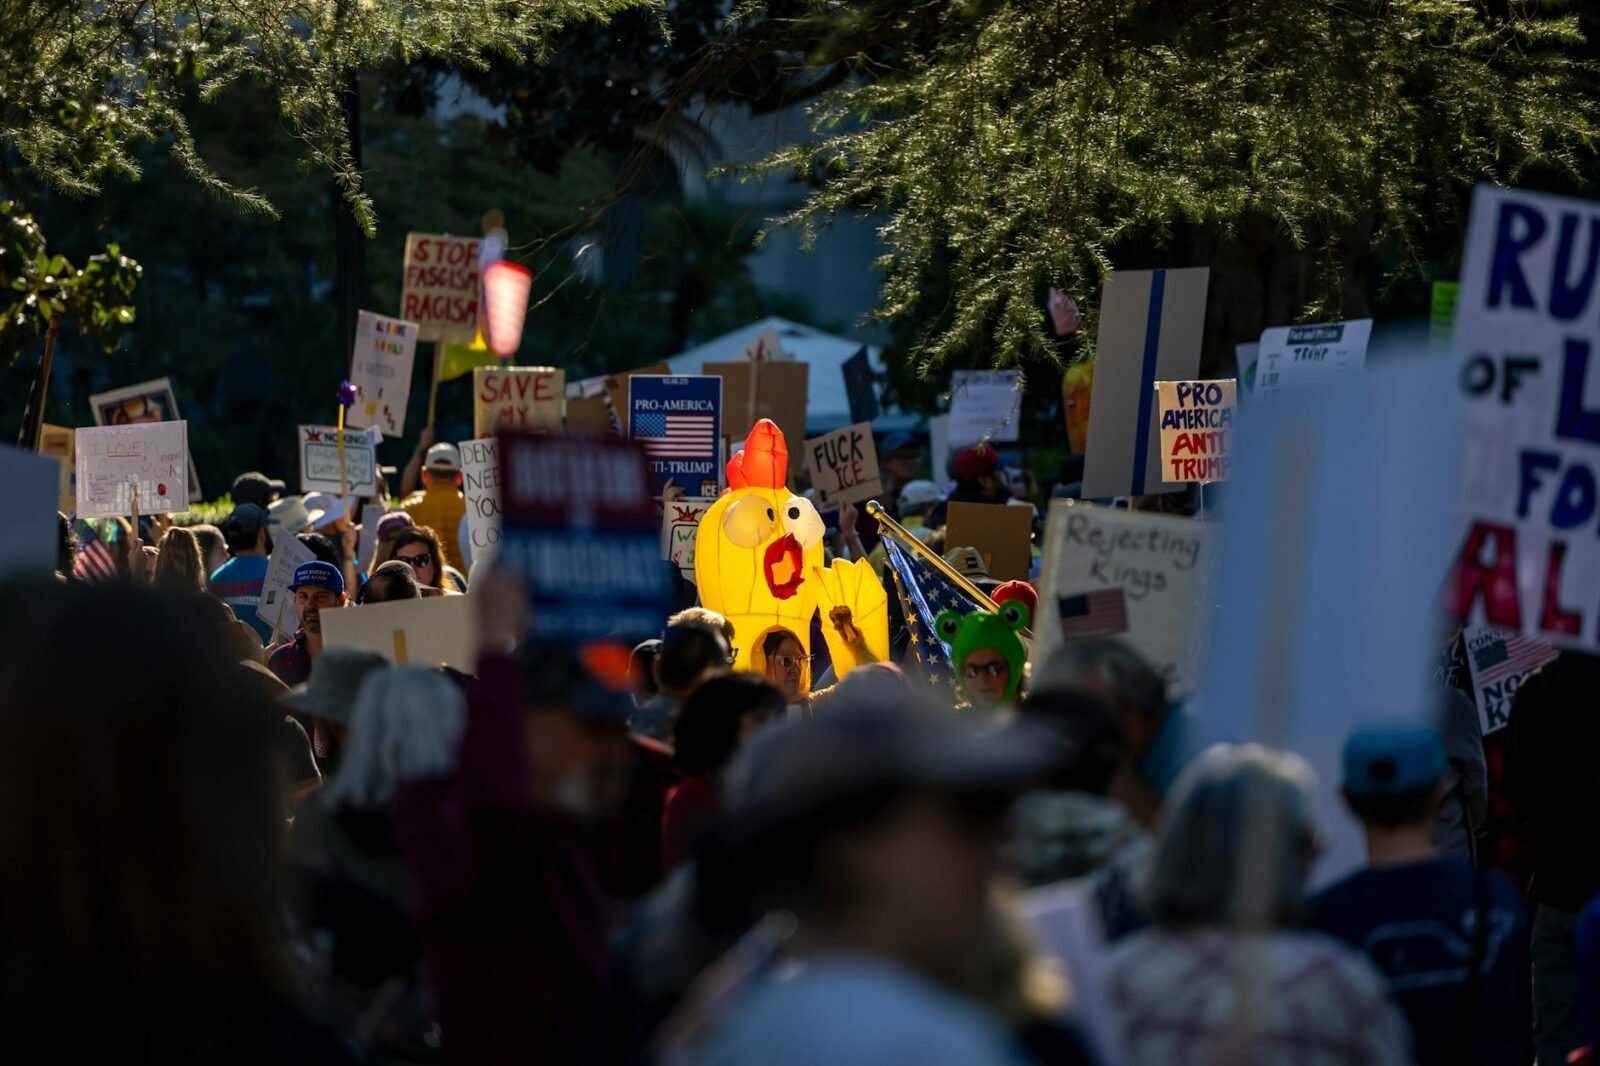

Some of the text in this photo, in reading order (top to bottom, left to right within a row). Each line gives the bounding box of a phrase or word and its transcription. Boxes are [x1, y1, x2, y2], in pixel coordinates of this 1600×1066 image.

[1487, 203, 1600, 321] RU
[1294, 347, 1329, 361] TRUMP
[480, 375, 554, 402] SAVE
[1177, 383, 1223, 408] PRO
[1460, 335, 1600, 443] OF L
[500, 405, 529, 425] MY
[635, 400, 714, 410] PRO-AMERICA
[1162, 408, 1231, 430] AMERICA
[107, 440, 141, 456] LOVE
[462, 443, 500, 465] DEM
[814, 431, 863, 473] FUCK
[1171, 432, 1226, 456] ANTI
[466, 468, 500, 490] NEE
[651, 461, 713, 473] TI-TRUMP
[835, 461, 864, 490] ICE
[1171, 457, 1229, 480] TRUMP
[701, 485, 717, 496] ICE
[1517, 451, 1600, 528] FO
[472, 527, 503, 548] CO
[1066, 513, 1199, 571] Rejecting
[1090, 557, 1168, 600] Kings
[1441, 518, 1600, 634] AL
[1468, 630, 1502, 650] CONS
[1482, 672, 1528, 704] NO
[1486, 697, 1514, 729] K
